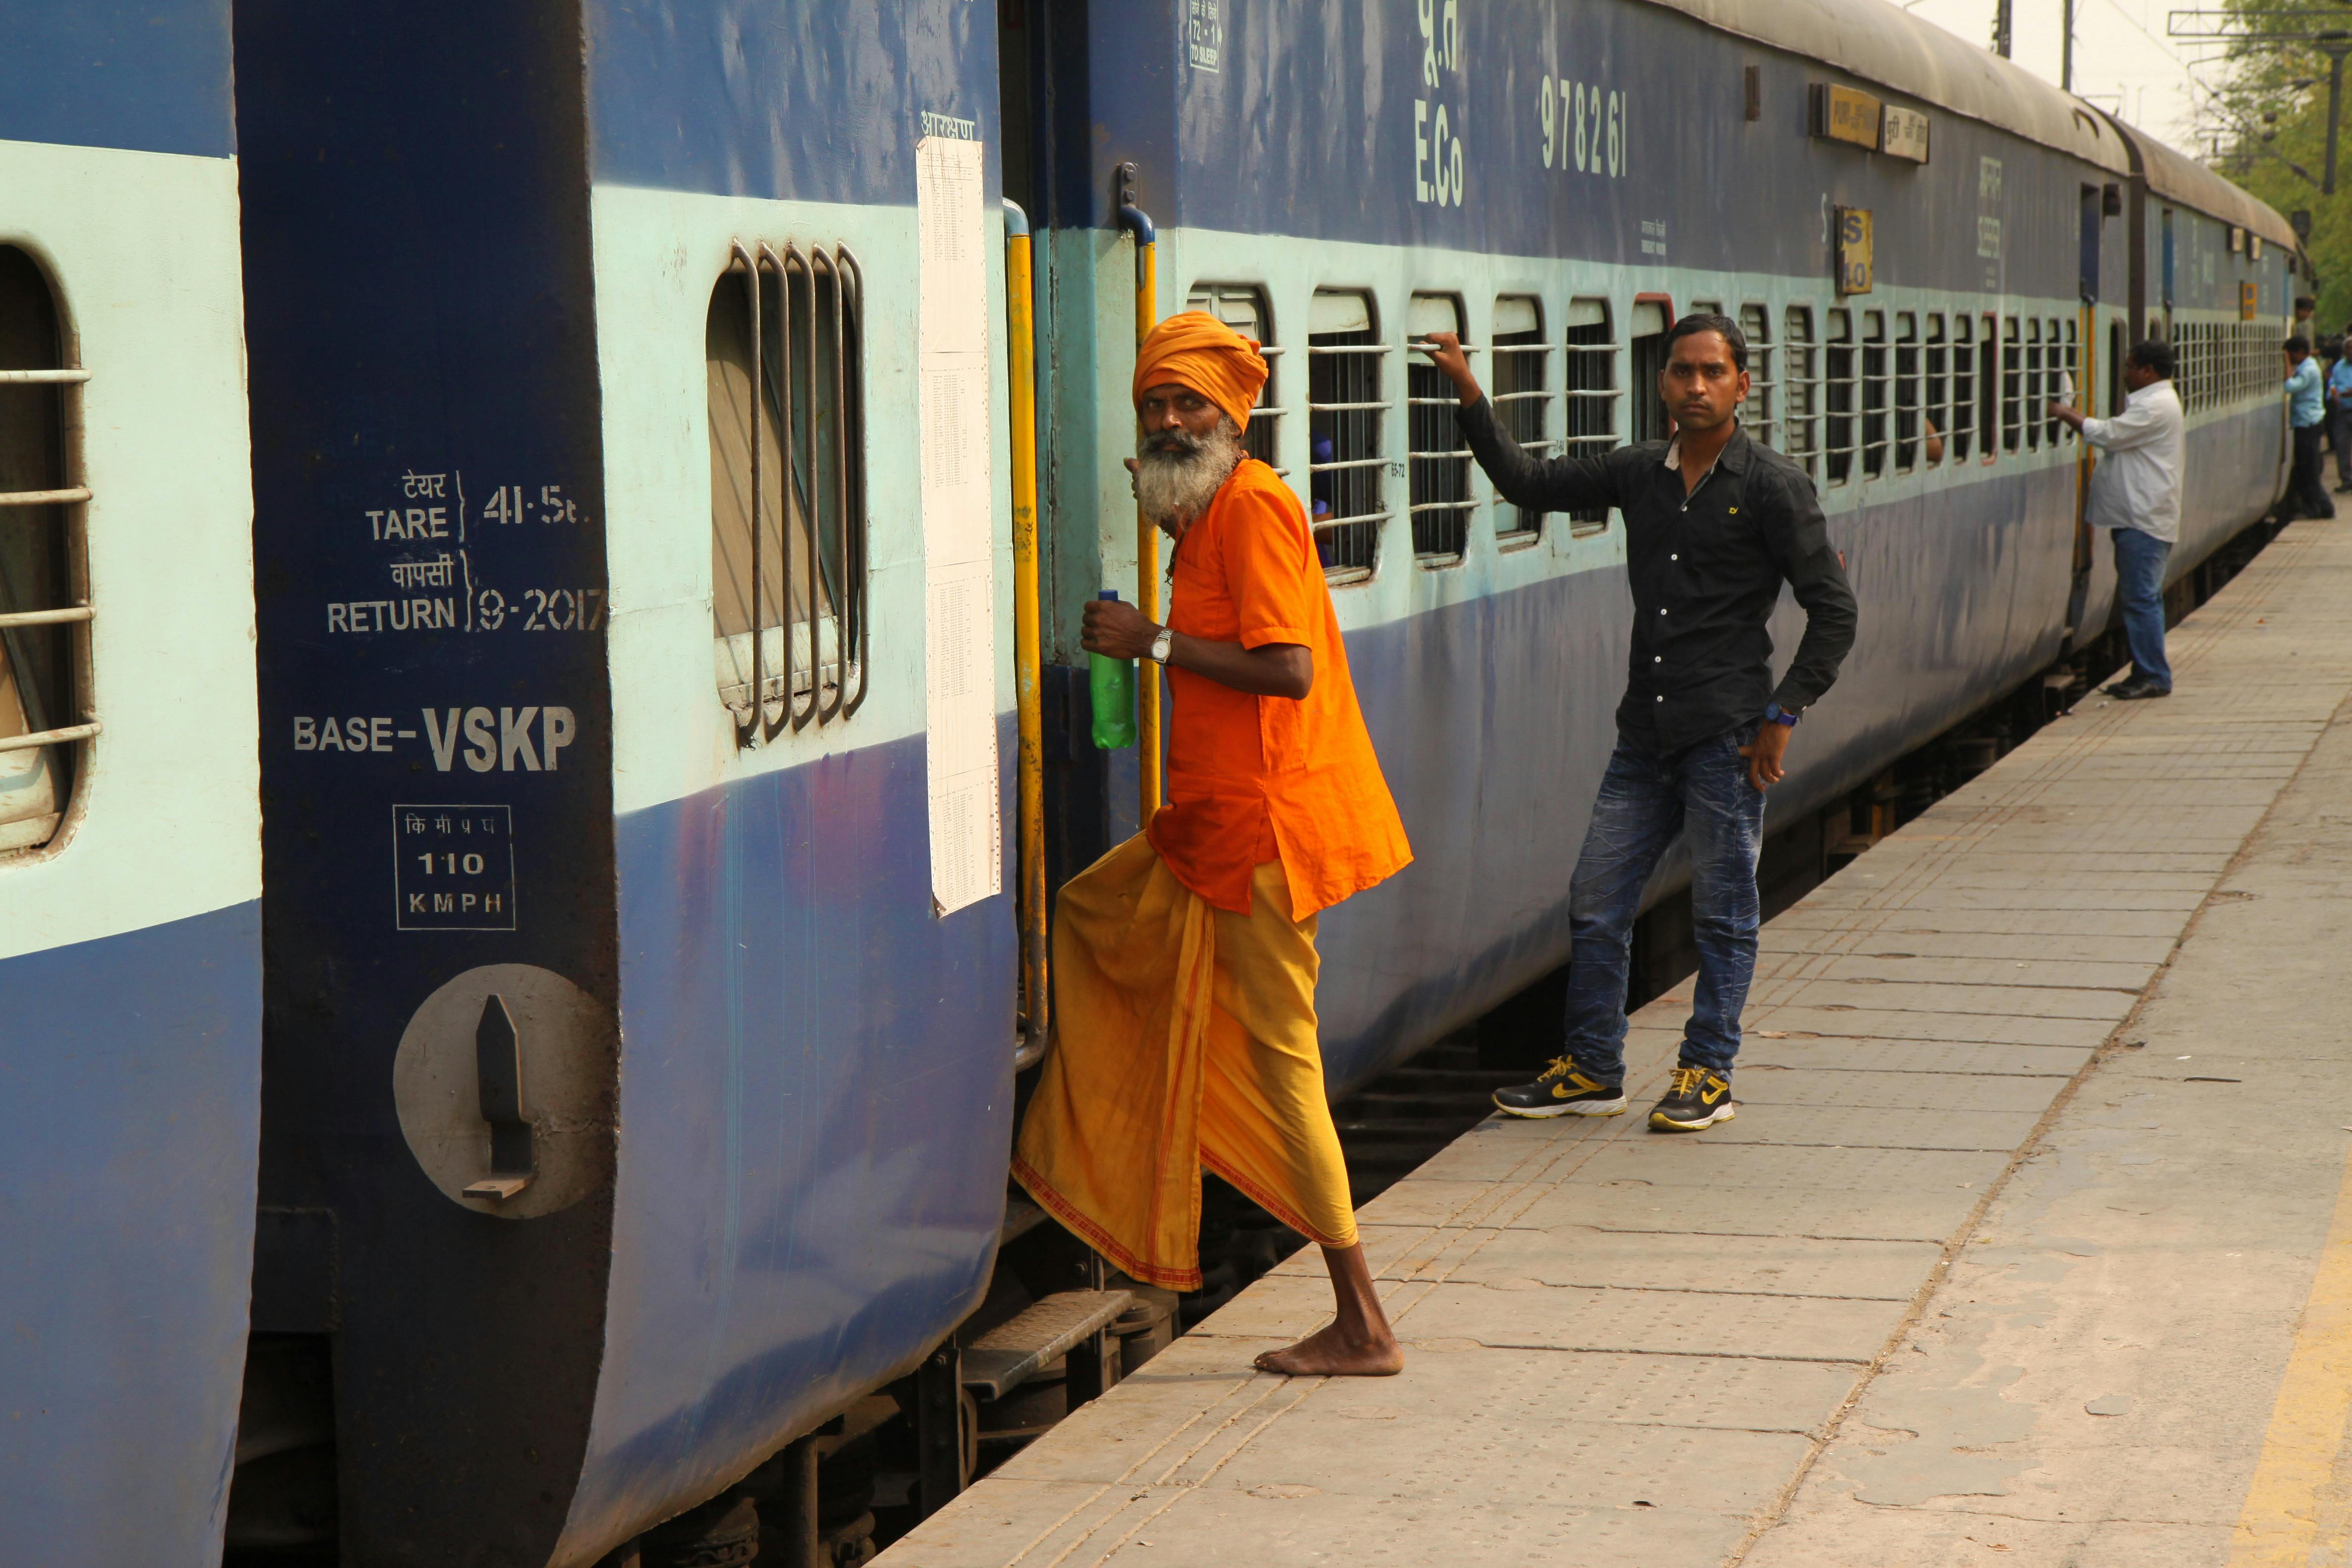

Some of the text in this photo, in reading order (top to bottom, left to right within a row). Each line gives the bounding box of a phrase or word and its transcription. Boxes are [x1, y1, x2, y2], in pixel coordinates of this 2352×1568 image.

[1193, 19, 1200, 41] 72
[1191, 44, 1217, 66] TO SLEEP
[921, 109, 975, 141] आरक्षण
[1541, 75, 1626, 178] 978261
[1844, 215, 1862, 244] S
[402, 469, 446, 498] टेयर
[365, 507, 448, 540] TARE
[390, 553, 454, 588] वापसी
[327, 597, 455, 633] RETURN
[479, 589, 609, 631] 9-2017
[418, 852, 484, 875] 110
